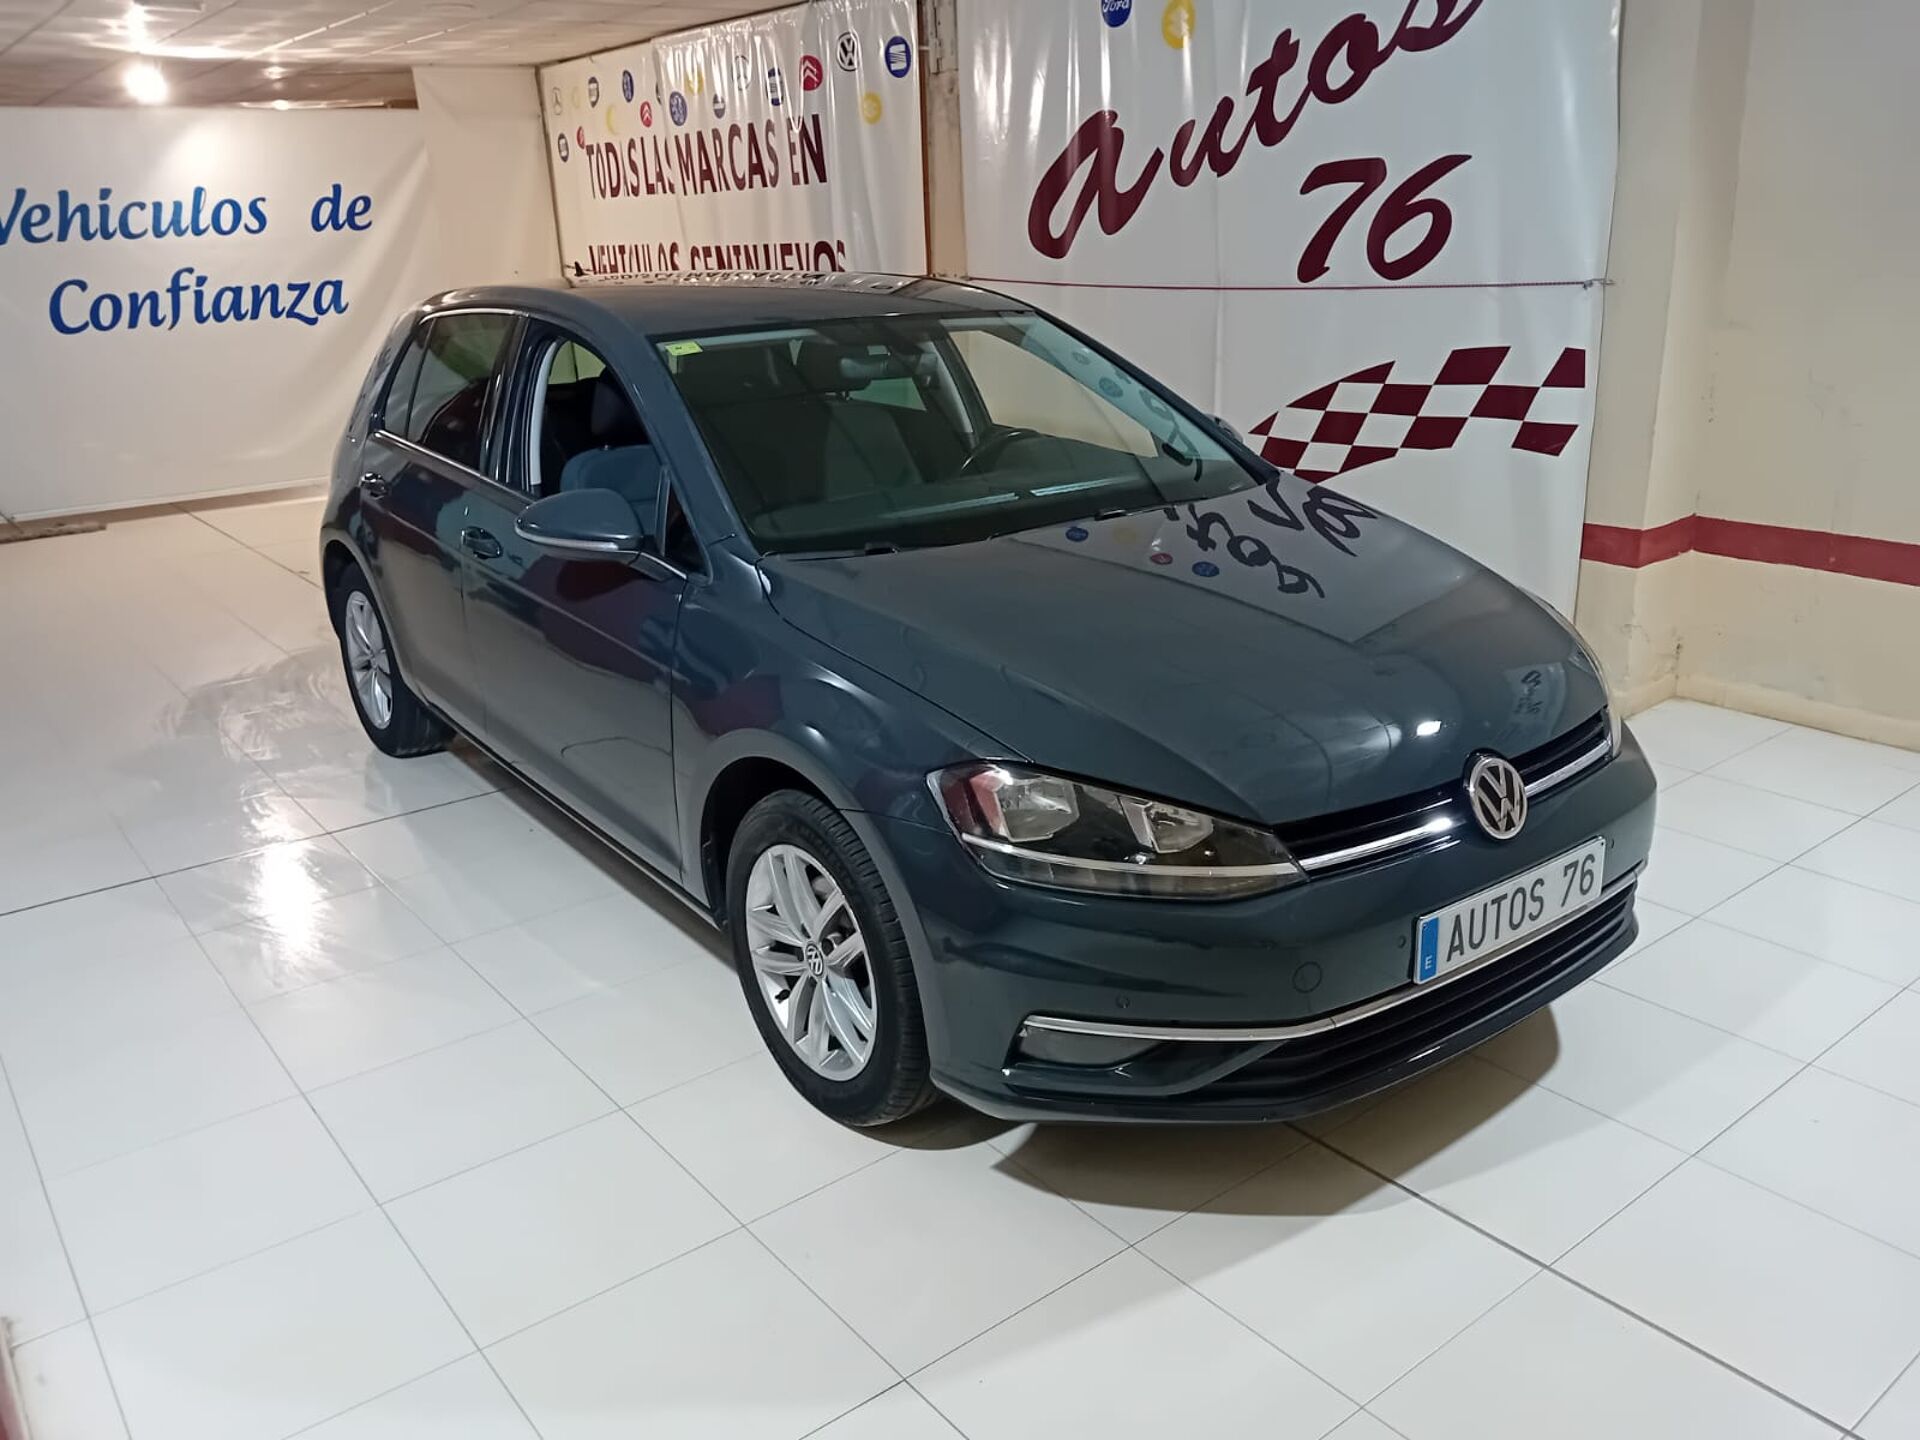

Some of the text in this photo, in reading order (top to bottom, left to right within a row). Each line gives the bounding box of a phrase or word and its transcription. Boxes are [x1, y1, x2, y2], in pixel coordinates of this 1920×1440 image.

[674, 118, 780, 196] MARCAS
[787, 113, 828, 186] EN
[311, 183, 373, 233] de
[1297, 154, 1472, 283] 76
[49, 266, 349, 335] Confianza
[1446, 877, 1545, 963] AUTOS
[1561, 853, 1596, 908] 76
